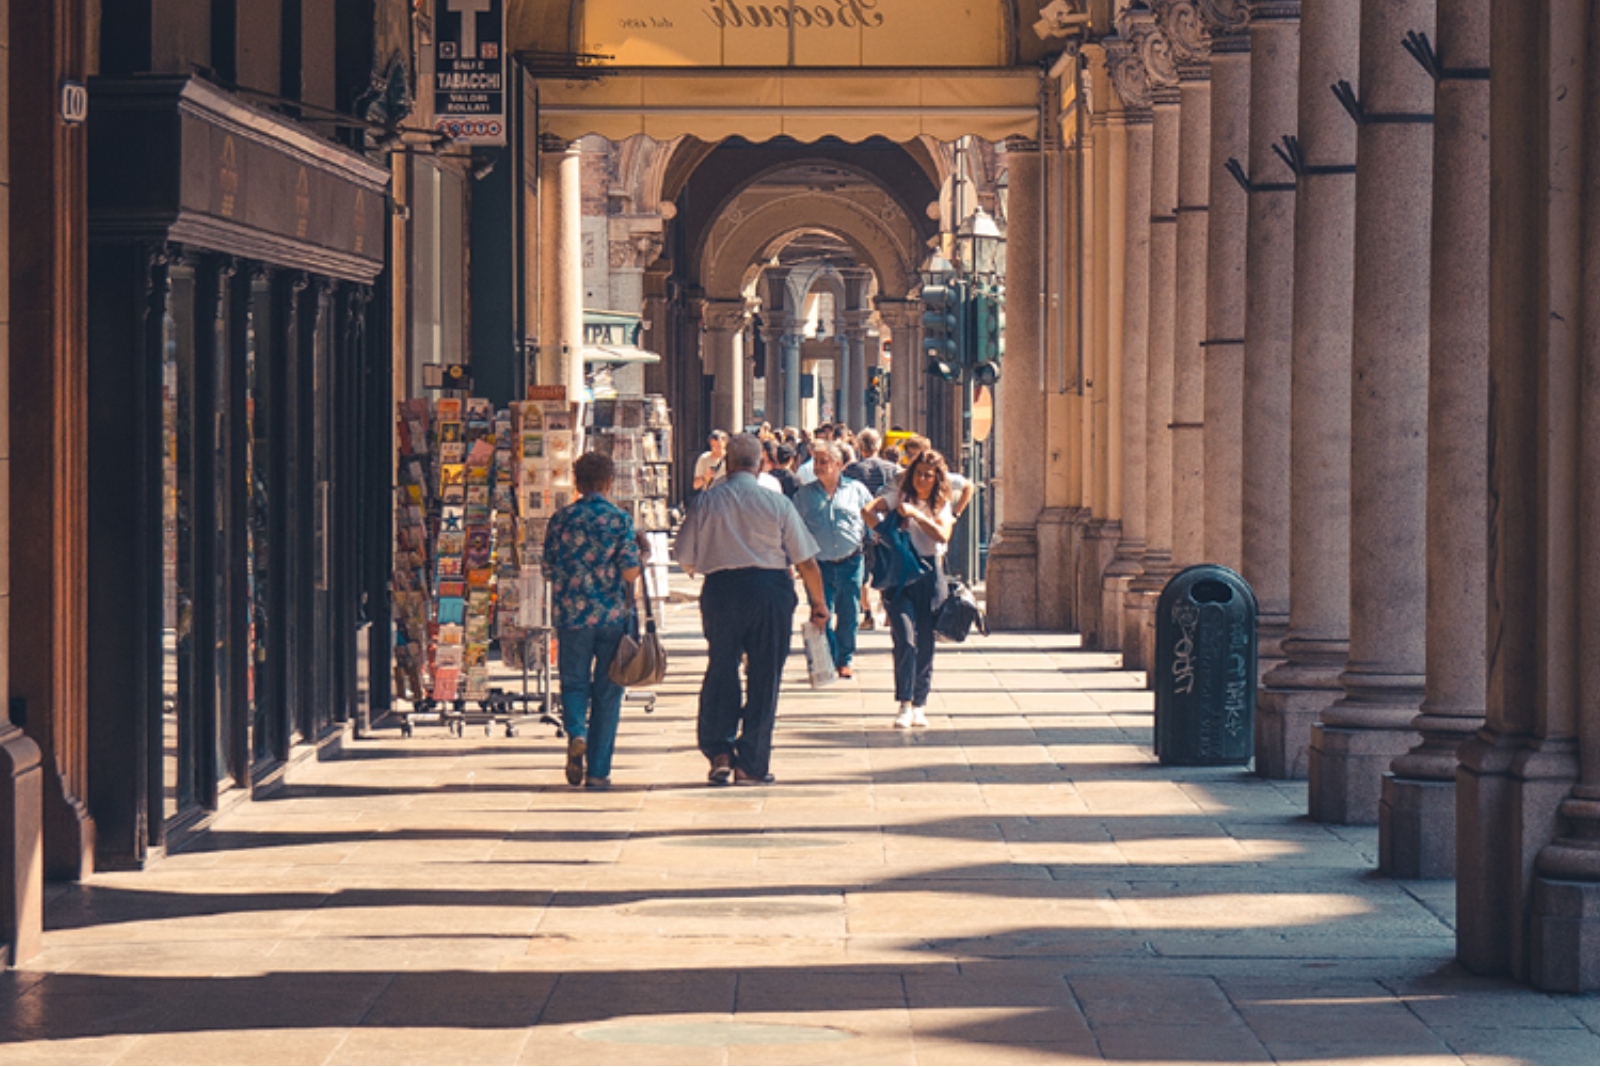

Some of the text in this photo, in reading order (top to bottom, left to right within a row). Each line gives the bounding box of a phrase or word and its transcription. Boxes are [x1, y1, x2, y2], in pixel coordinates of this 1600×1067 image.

[447, 0, 491, 58] T
[437, 73, 500, 89] TABACCHI
[66, 89, 82, 116] 10
[450, 94, 488, 102] VALORI
[448, 103, 490, 112] BOLLATI
